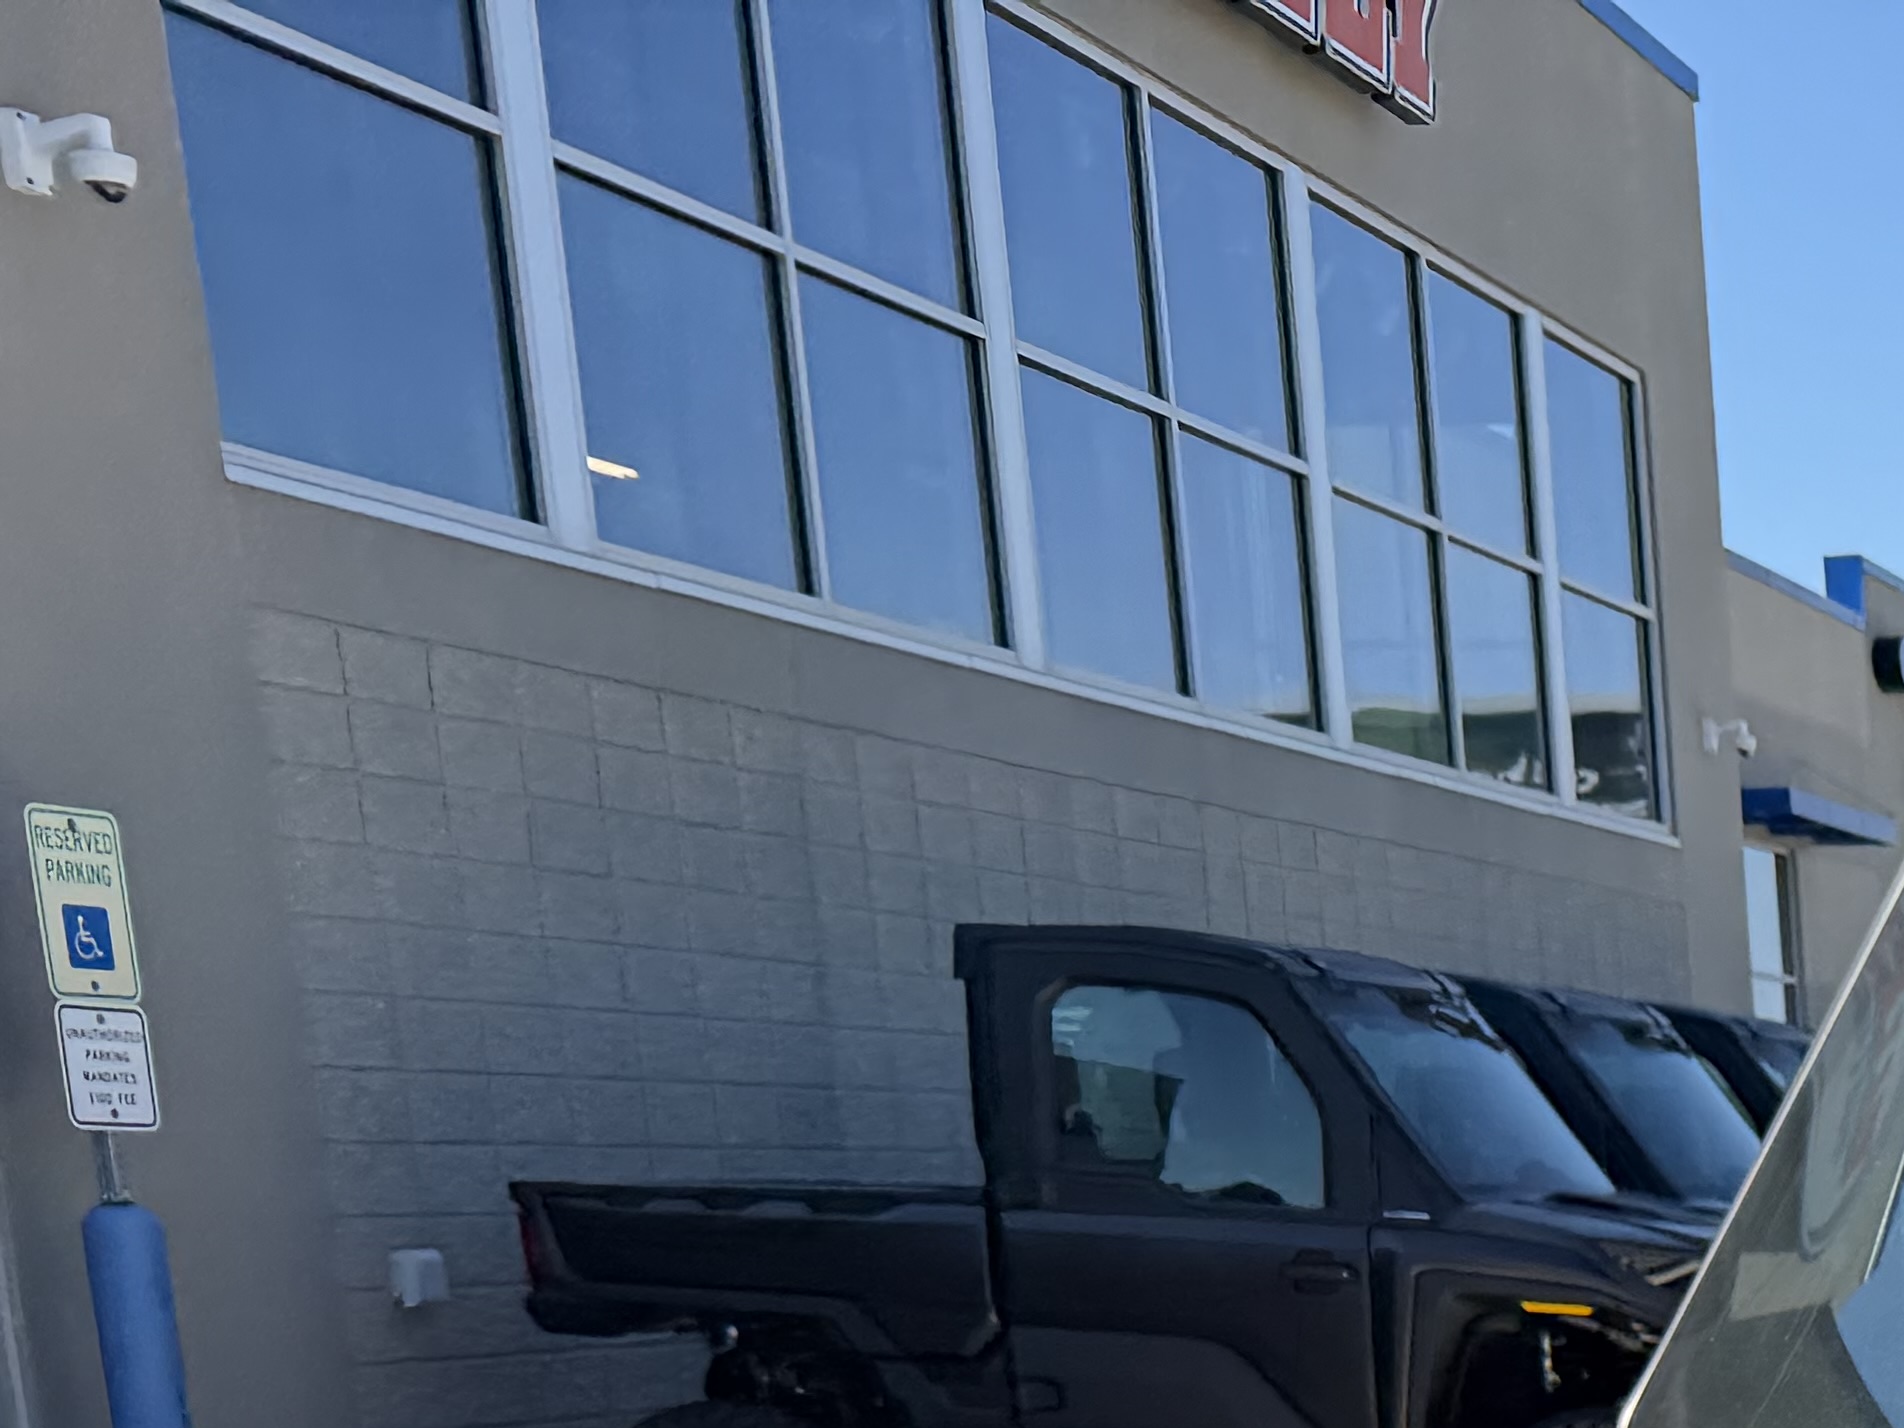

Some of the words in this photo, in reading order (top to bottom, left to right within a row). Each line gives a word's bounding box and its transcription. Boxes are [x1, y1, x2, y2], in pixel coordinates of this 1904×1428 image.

[34, 825, 113, 854] RESERVED
[45, 859, 111, 887] PARKING
[85, 1049, 131, 1063] PARKING
